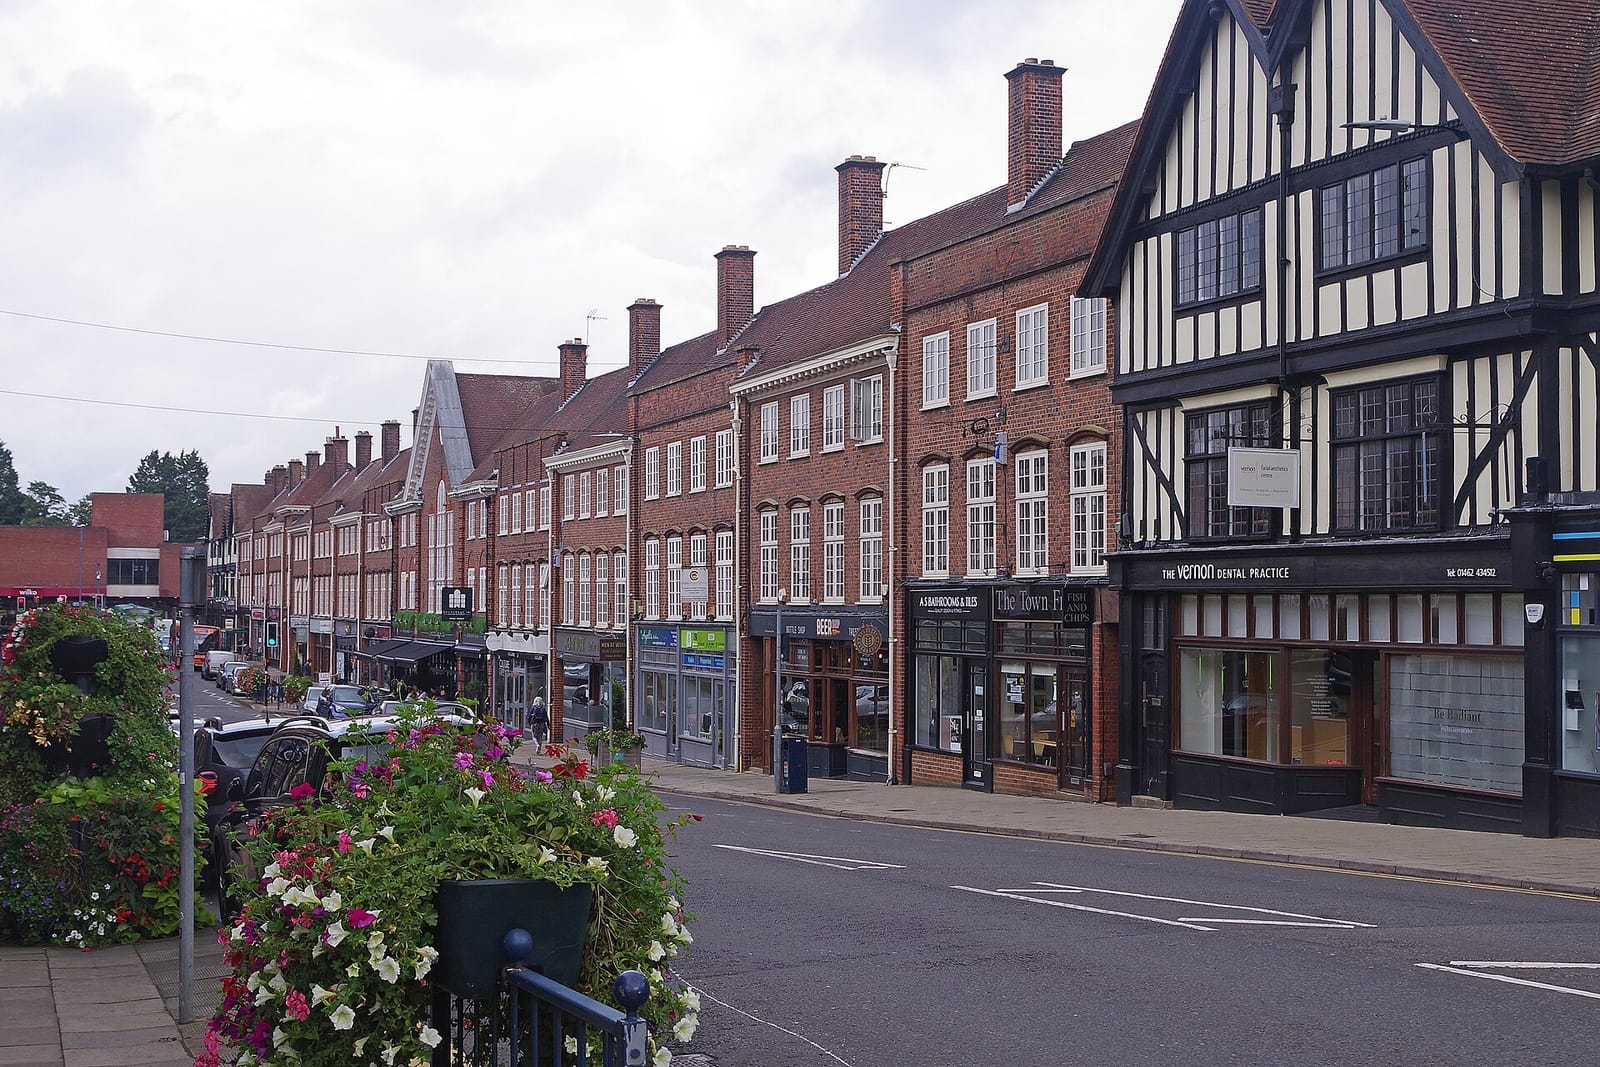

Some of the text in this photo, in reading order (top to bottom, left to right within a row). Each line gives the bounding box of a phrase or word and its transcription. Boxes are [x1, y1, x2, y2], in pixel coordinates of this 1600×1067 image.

[1162, 564, 1290, 580] THE vernon DENTAL PRACTICE
[1457, 568, 1475, 577] 01462
[928, 596, 960, 607] BATHROOMS
[995, 589, 1016, 611] The
[1019, 590, 1049, 611] Town
[1067, 593, 1087, 602] FISH
[1066, 603, 1088, 612] AND
[1064, 613, 1090, 623] CHIPS
[816, 618, 832, 635] BEER
